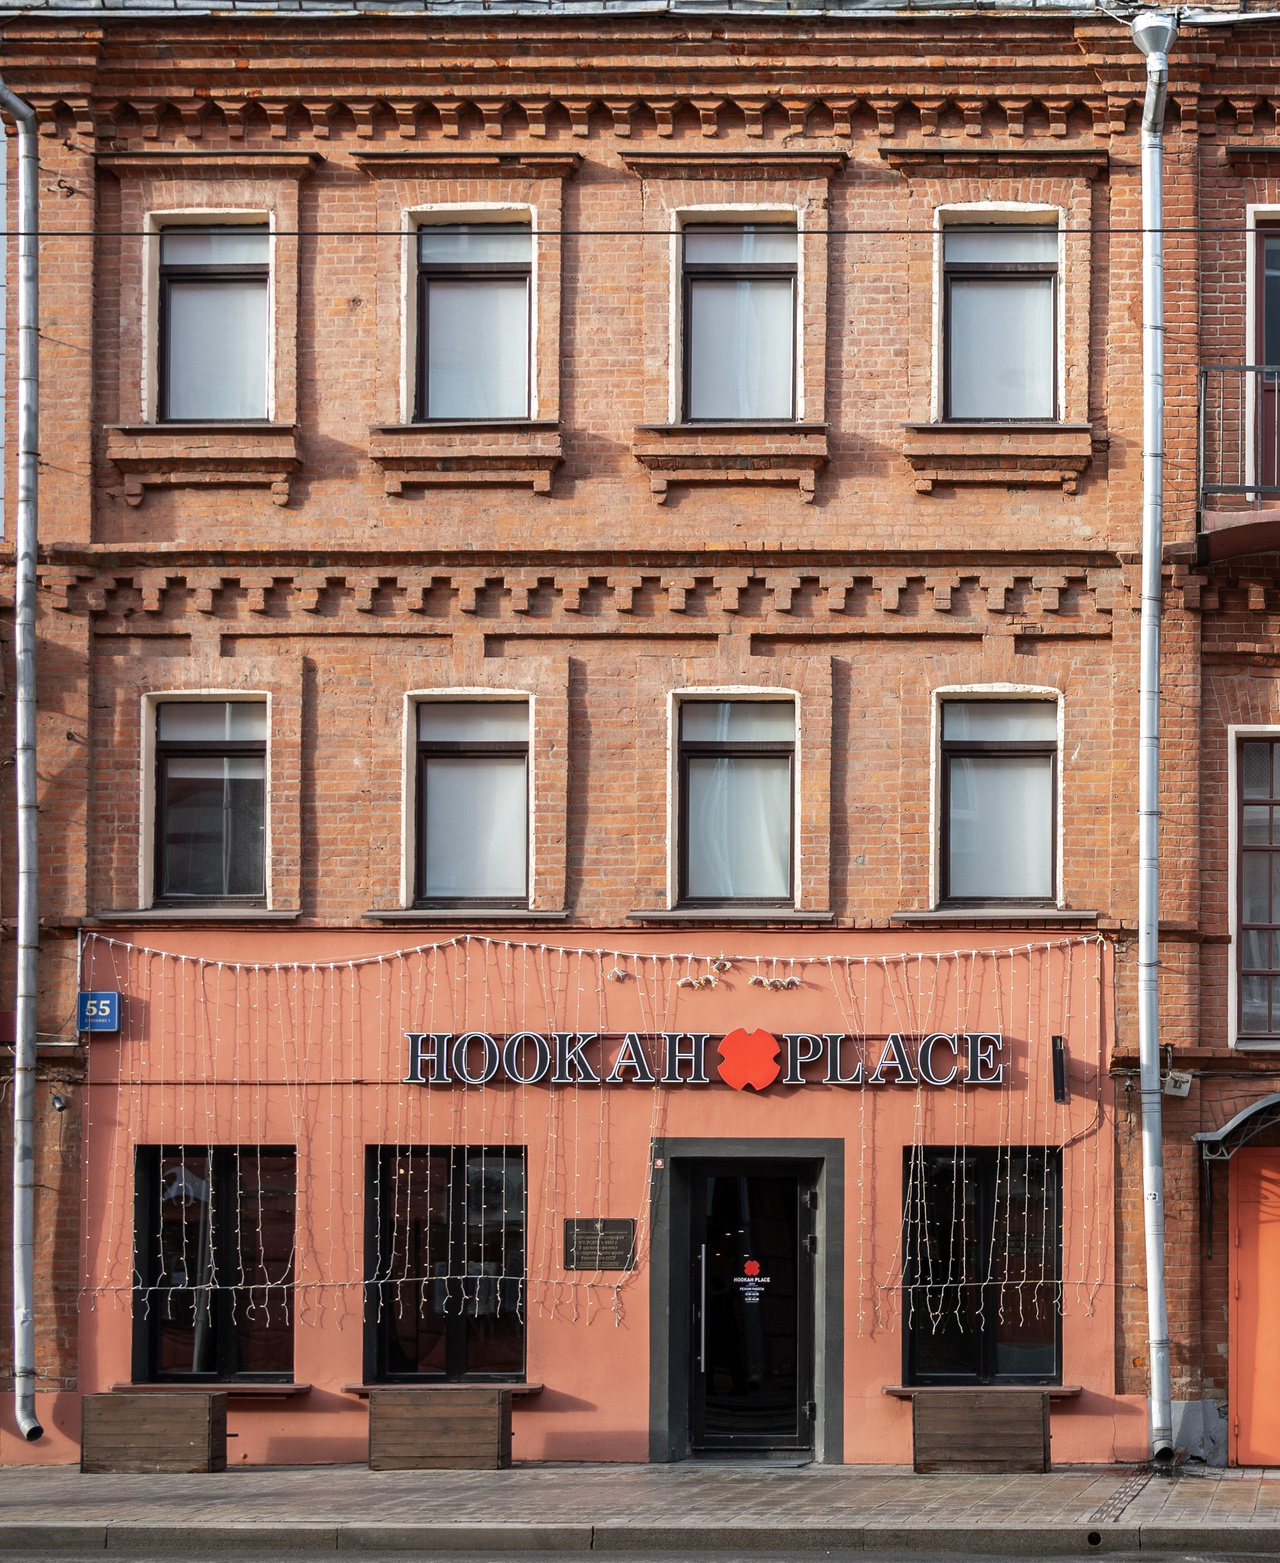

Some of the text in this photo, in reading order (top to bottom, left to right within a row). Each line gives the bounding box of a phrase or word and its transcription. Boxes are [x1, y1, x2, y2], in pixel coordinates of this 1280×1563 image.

[85, 1000, 111, 1017] 55
[403, 1031, 1004, 1086] HOOKAH PLACE
